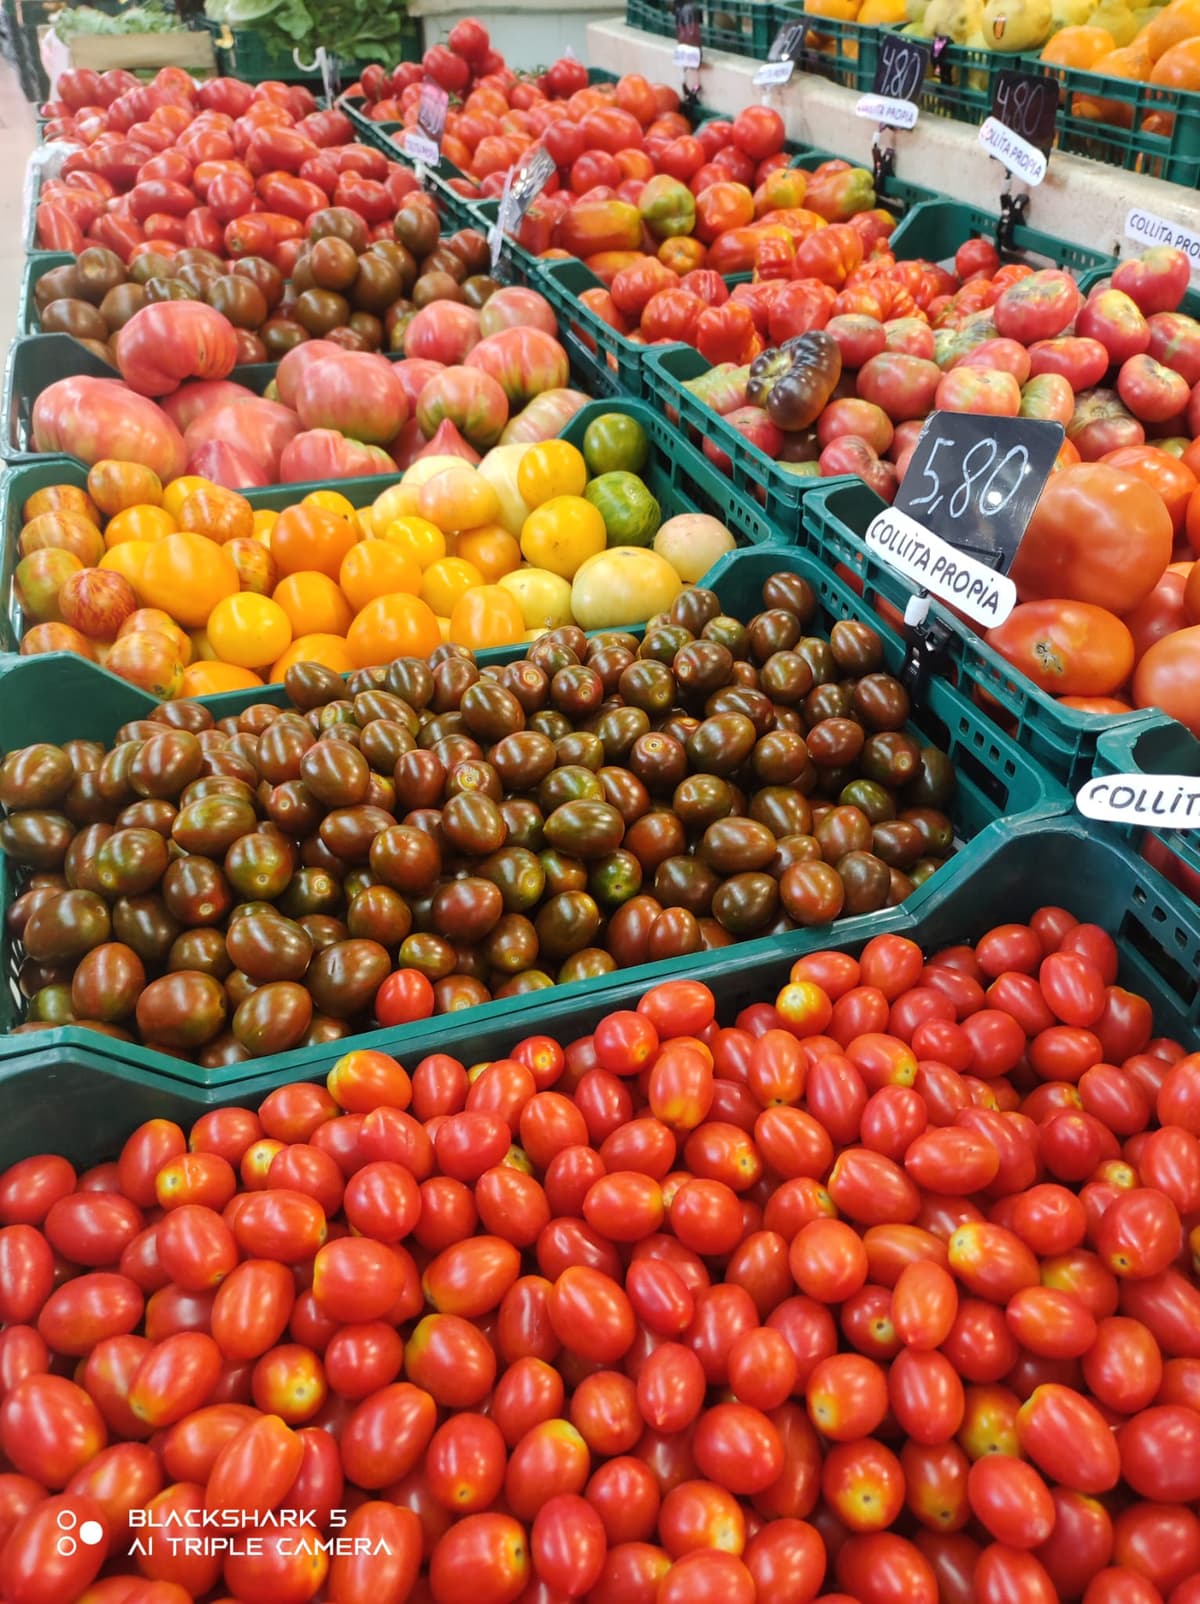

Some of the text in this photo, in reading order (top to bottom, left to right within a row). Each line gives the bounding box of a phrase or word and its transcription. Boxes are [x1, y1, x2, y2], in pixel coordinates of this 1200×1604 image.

[1129, 213, 1200, 260] COLLITA PRO
[909, 437, 1029, 519] 5,80
[870, 518, 1001, 615] COLLITA PROPIA
[1089, 784, 1200, 816] COLLIT
